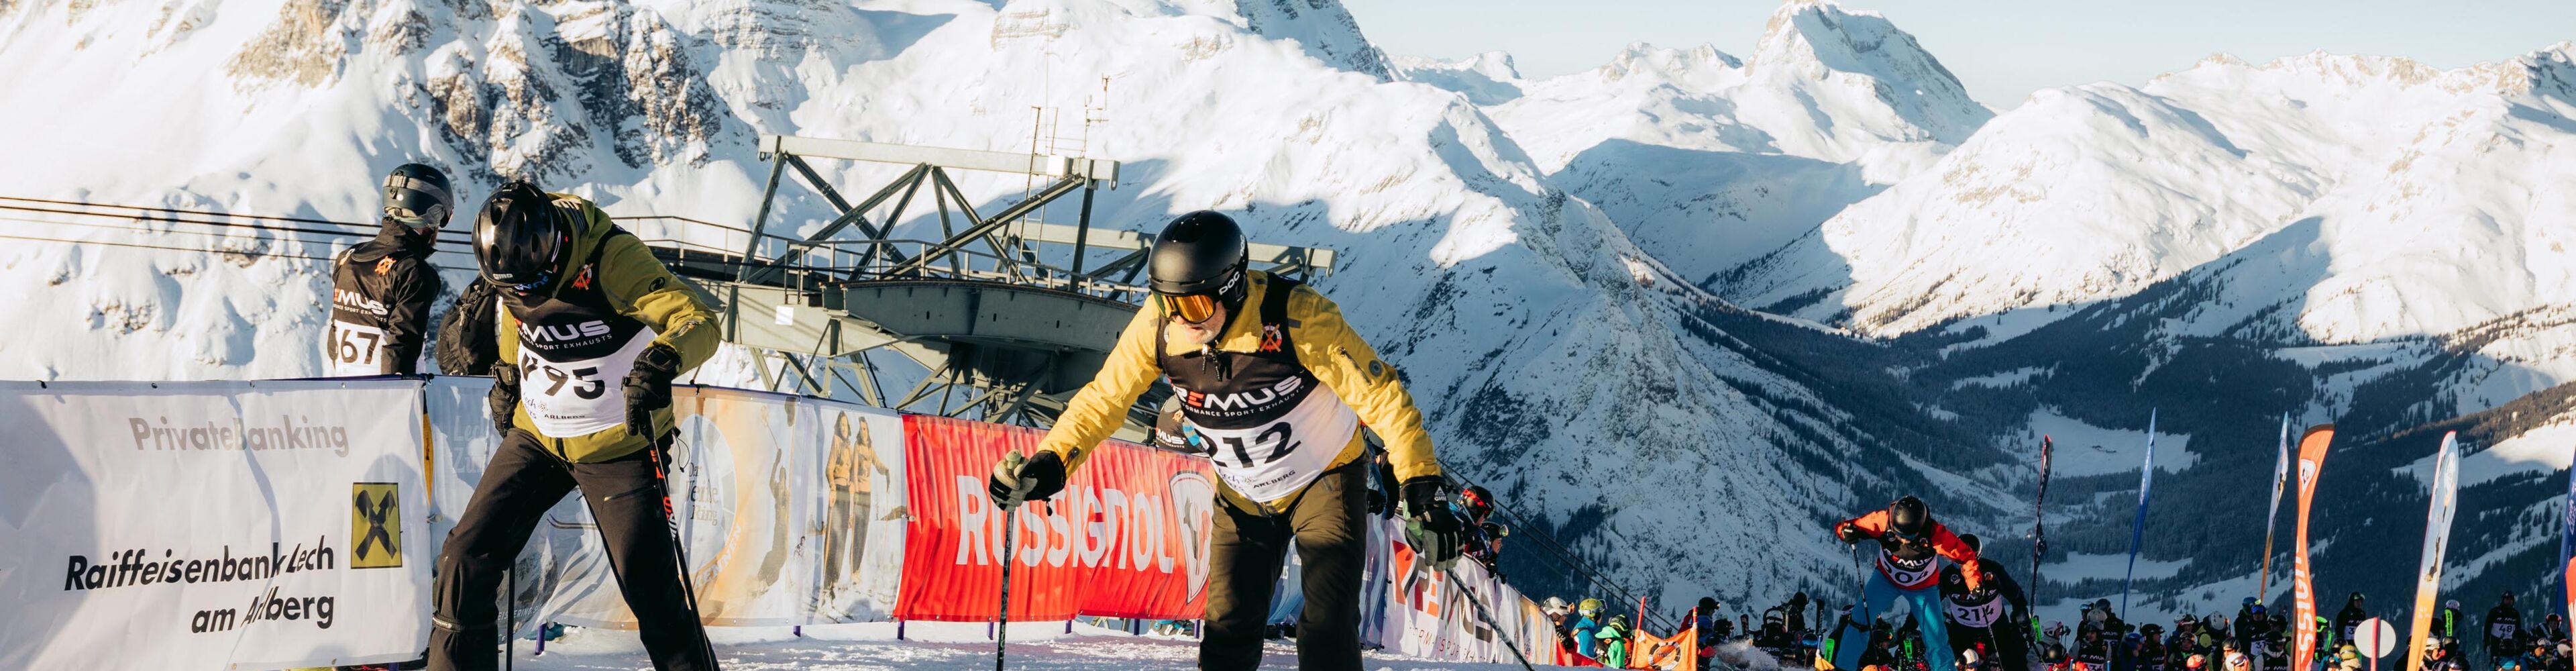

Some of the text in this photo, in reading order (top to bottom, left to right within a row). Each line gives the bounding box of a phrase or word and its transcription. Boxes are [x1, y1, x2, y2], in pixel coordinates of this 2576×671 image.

[1218, 271, 1240, 295] POC
[334, 288, 388, 315] EMUS
[515, 317, 610, 342] MUS
[564, 333, 612, 348] EXHAUSTS
[1173, 375, 1302, 411] REMUS
[1225, 409, 1254, 417] SPORT
[1259, 384, 1305, 412] EXHAUSTS
[129, 414, 348, 458] PrivateBanking
[1155, 427, 1184, 445] MUS
[1194, 421, 1301, 468] 212
[1253, 470, 1296, 488] ARLBERG
[956, 476, 1174, 574] ROSSIGNOL
[64, 535, 334, 591] Raiffeisenbank Lech
[191, 586, 334, 633] am Arlberg
[1958, 605, 1994, 621] 214
